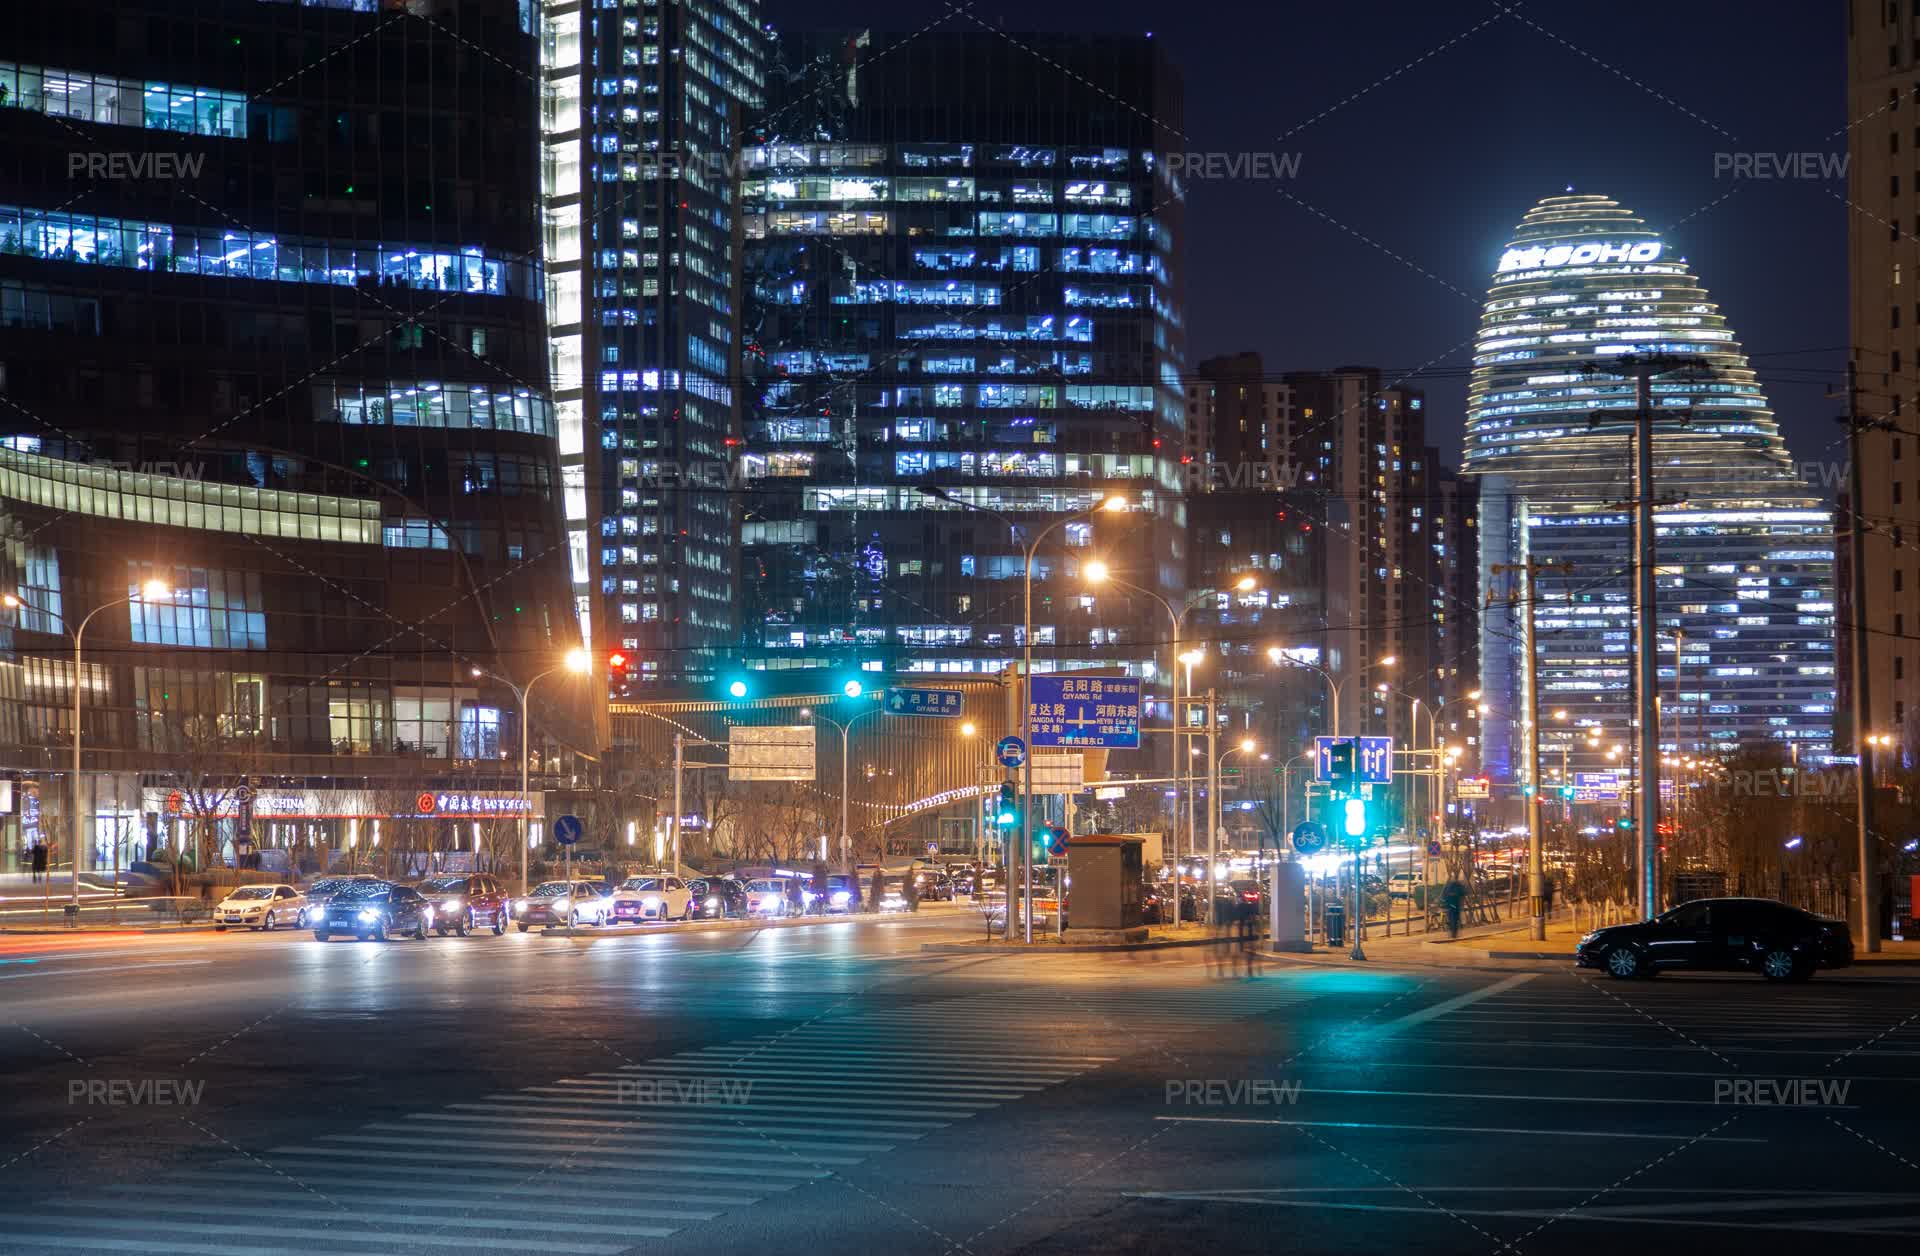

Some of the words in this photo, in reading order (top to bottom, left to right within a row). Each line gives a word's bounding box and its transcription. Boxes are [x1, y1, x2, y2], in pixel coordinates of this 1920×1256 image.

[1062, 680, 1102, 692] 启阳路
[910, 693, 957, 705] 启阳路
[272, 799, 305, 809] CHINA
